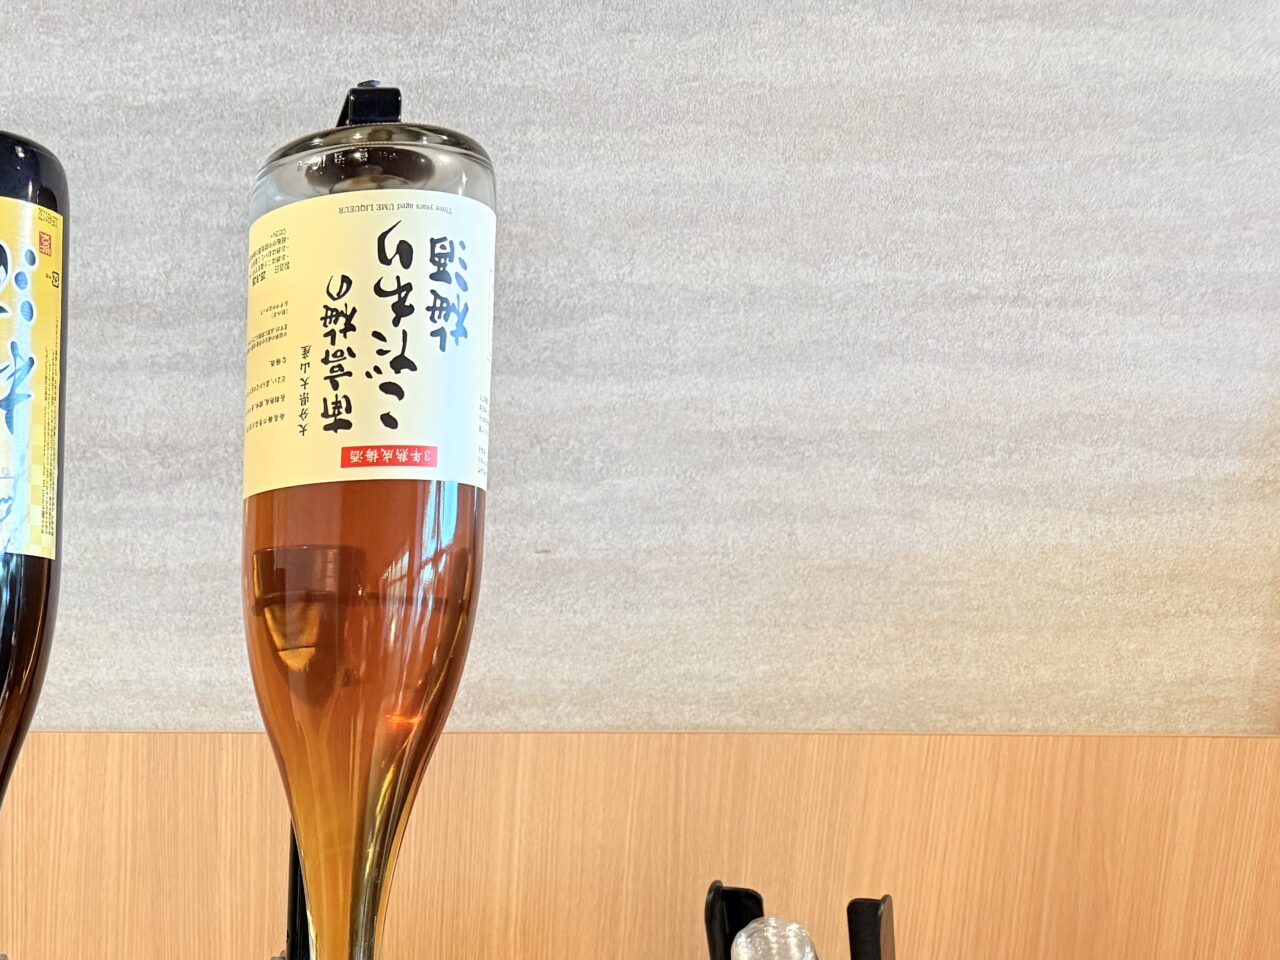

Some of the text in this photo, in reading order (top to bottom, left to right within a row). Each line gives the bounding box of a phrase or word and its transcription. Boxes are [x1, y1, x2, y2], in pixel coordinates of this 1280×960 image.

[338, 204, 373, 214] LIQUEUR
[397, 202, 414, 211] aged
[365, 220, 417, 430] こだわり
[425, 235, 470, 352] 梅酒
[298, 345, 312, 436] 大分県大山産
[320, 274, 357, 434] 南高梅の
[350, 447, 430, 463] 3年熟成梅酒
